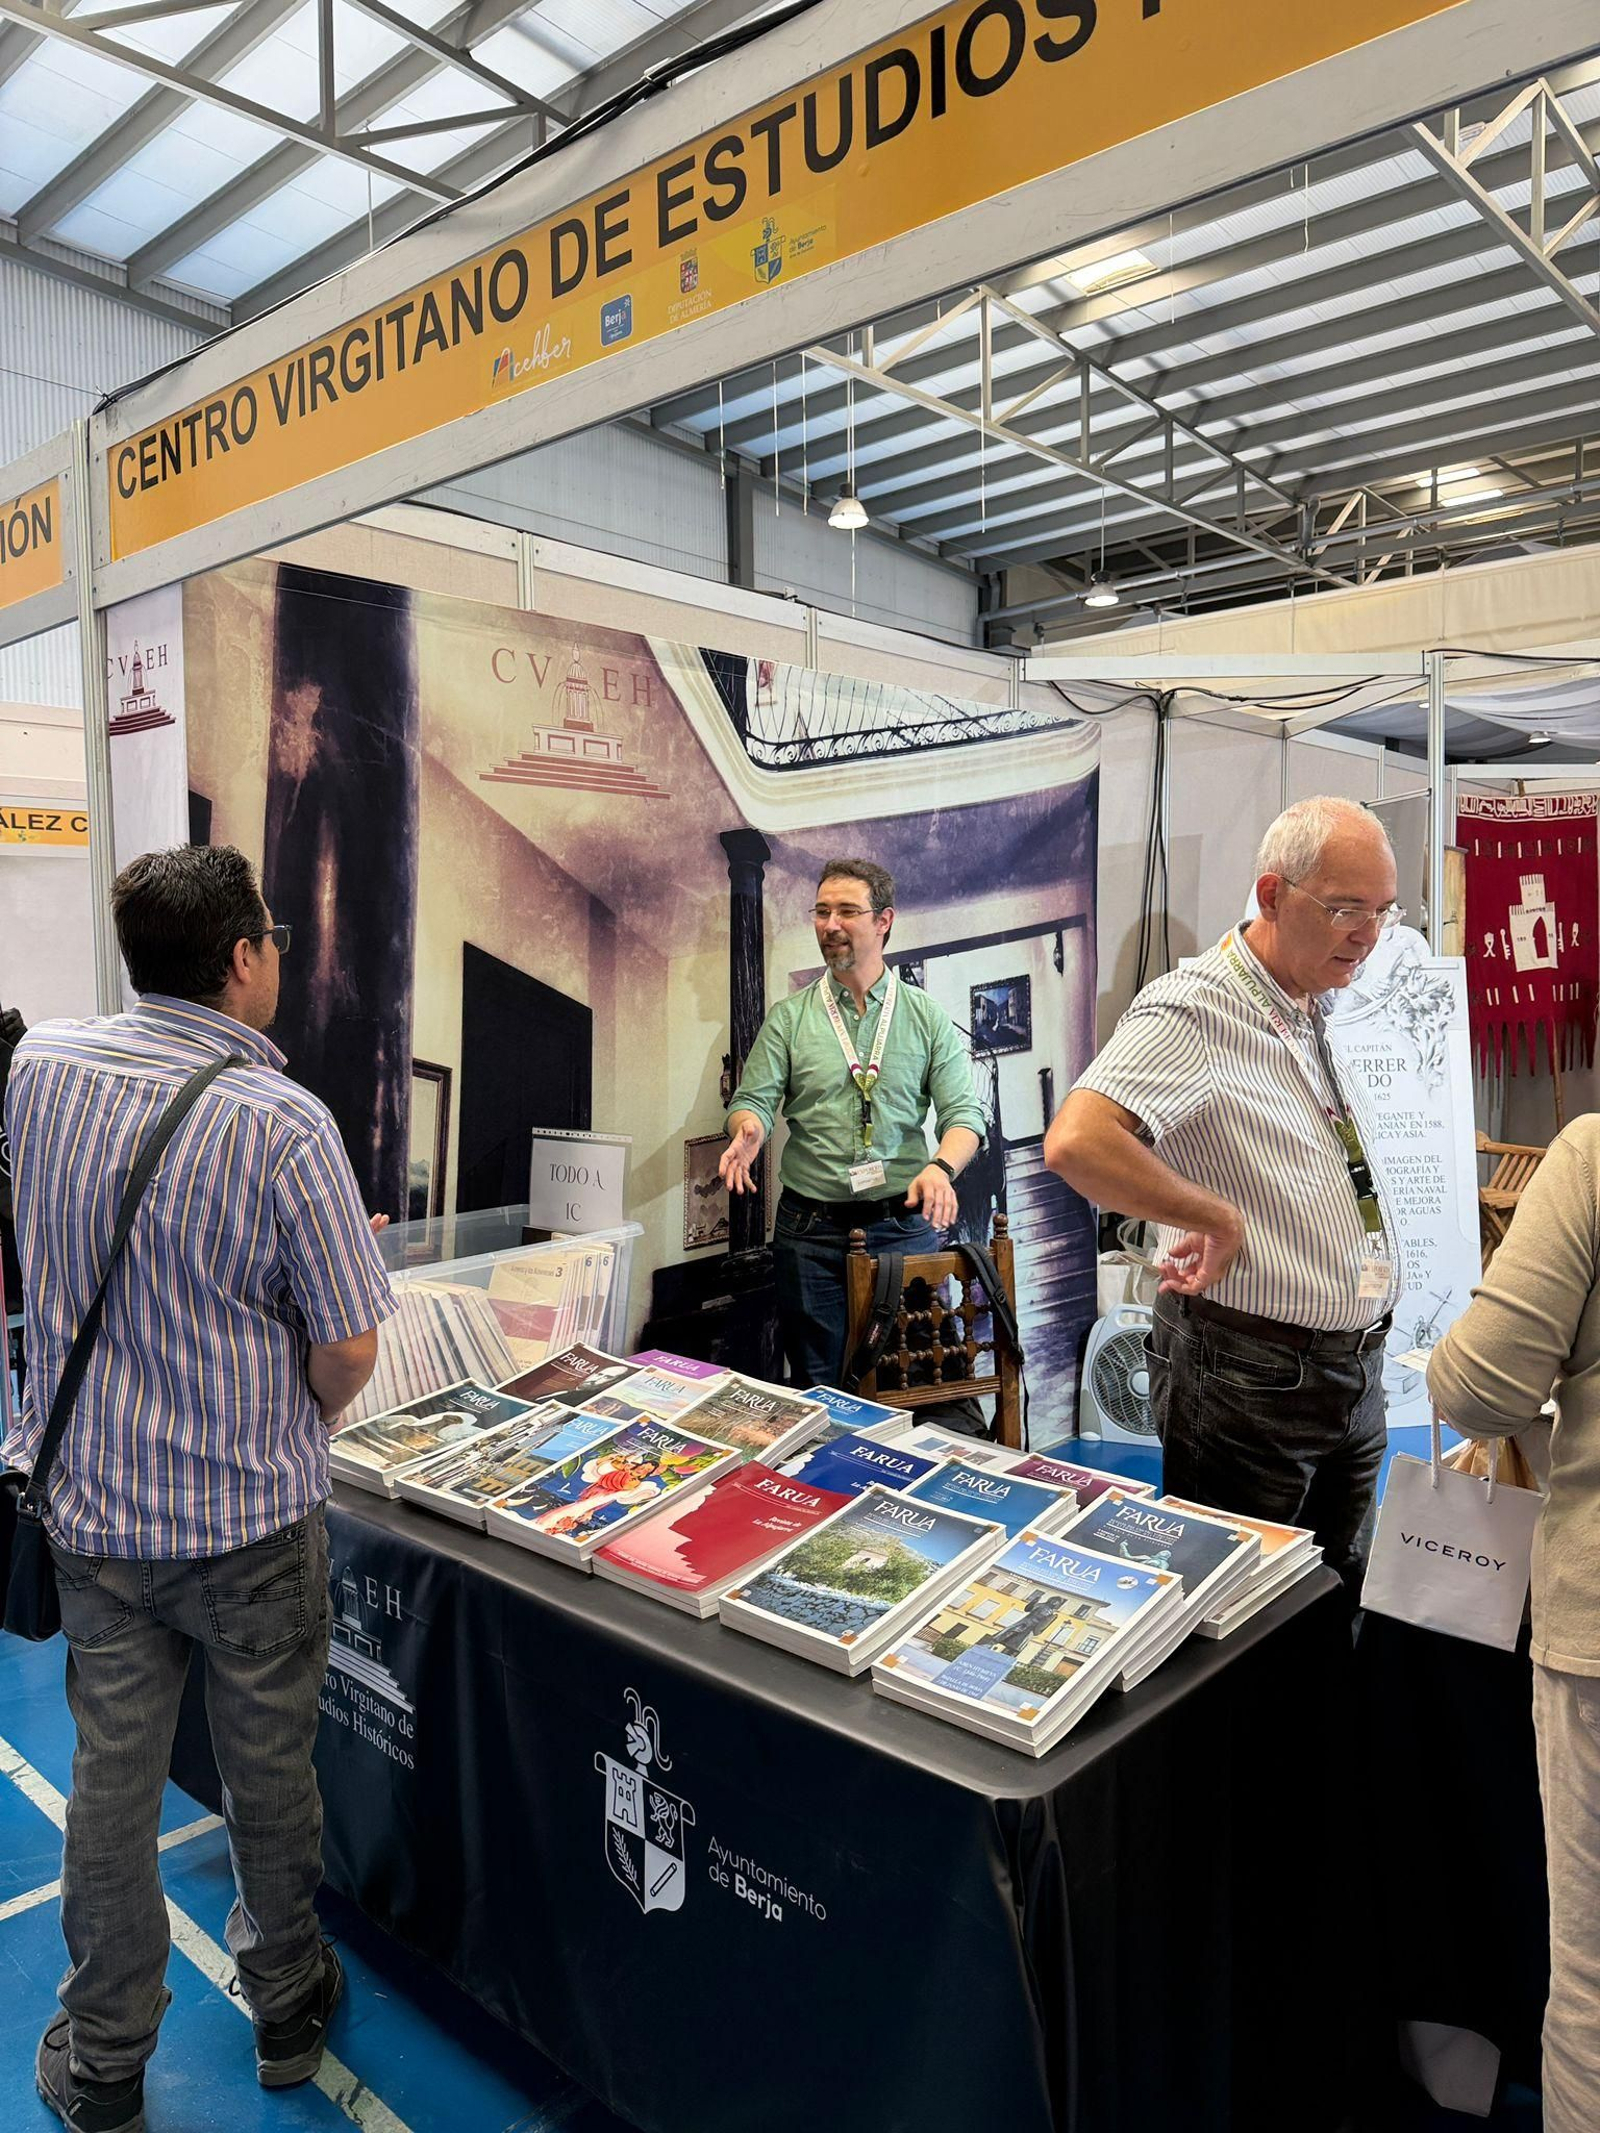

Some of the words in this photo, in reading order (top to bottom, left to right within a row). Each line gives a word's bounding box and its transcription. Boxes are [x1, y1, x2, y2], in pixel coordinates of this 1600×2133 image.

[117, 386, 257, 499] CENTRO
[270, 248, 528, 427] VIRGITANO
[550, 192, 633, 300] DE
[657, 0, 1097, 249] ESTUDIOS
[604, 308, 627, 328] Berja
[1226, 949, 1273, 1008] ALPUJARRA
[1376, 1111, 1415, 1121] EGANTE
[1418, 1110, 1425, 1120] Y
[1410, 1120, 1422, 1129] EN
[1424, 1154, 1443, 1163] DEL
[550, 1163, 589, 1185] TODO
[592, 1169, 606, 1191] A
[1408, 1175, 1431, 1184] ARTE
[1433, 1174, 1447, 1184] DE
[1404, 1195, 1442, 1205] MEJORA
[1417, 1184, 1447, 1194] NAVAL
[1409, 1205, 1442, 1216] AGUAS
[1401, 1237, 1438, 1248] ABLES,
[555, 1266, 563, 1278] 3
[585, 1256, 593, 1267] 6
[602, 1255, 610, 1267] 6
[560, 1352, 600, 1375] FARUA
[653, 1355, 700, 1372] FARUA
[644, 1375, 687, 1394] FARUA
[460, 1389, 501, 1411] FARUA
[729, 1388, 777, 1414] FARUA
[816, 1393, 863, 1413] FARUA
[570, 1418, 610, 1436] FARUA
[637, 1427, 688, 1455] FARUA
[849, 1446, 914, 1474] FARUA
[951, 1471, 1012, 1499] FARUA
[1034, 1463, 1094, 1487] FARUA
[754, 1478, 821, 1508] FARUA
[874, 1500, 937, 1533] FARUA
[1116, 1505, 1185, 1539] FARUA
[1400, 1532, 1507, 1571] VICEROY
[1027, 1546, 1102, 1584] FARUA
[339, 1674, 395, 1728] Virgitano
[398, 1714, 415, 1739] de
[352, 1711, 415, 1770] Históricos
[708, 1836, 827, 1920] Ayuntamiento
[708, 1862, 730, 1888] de
[735, 1873, 783, 1922] Berja
